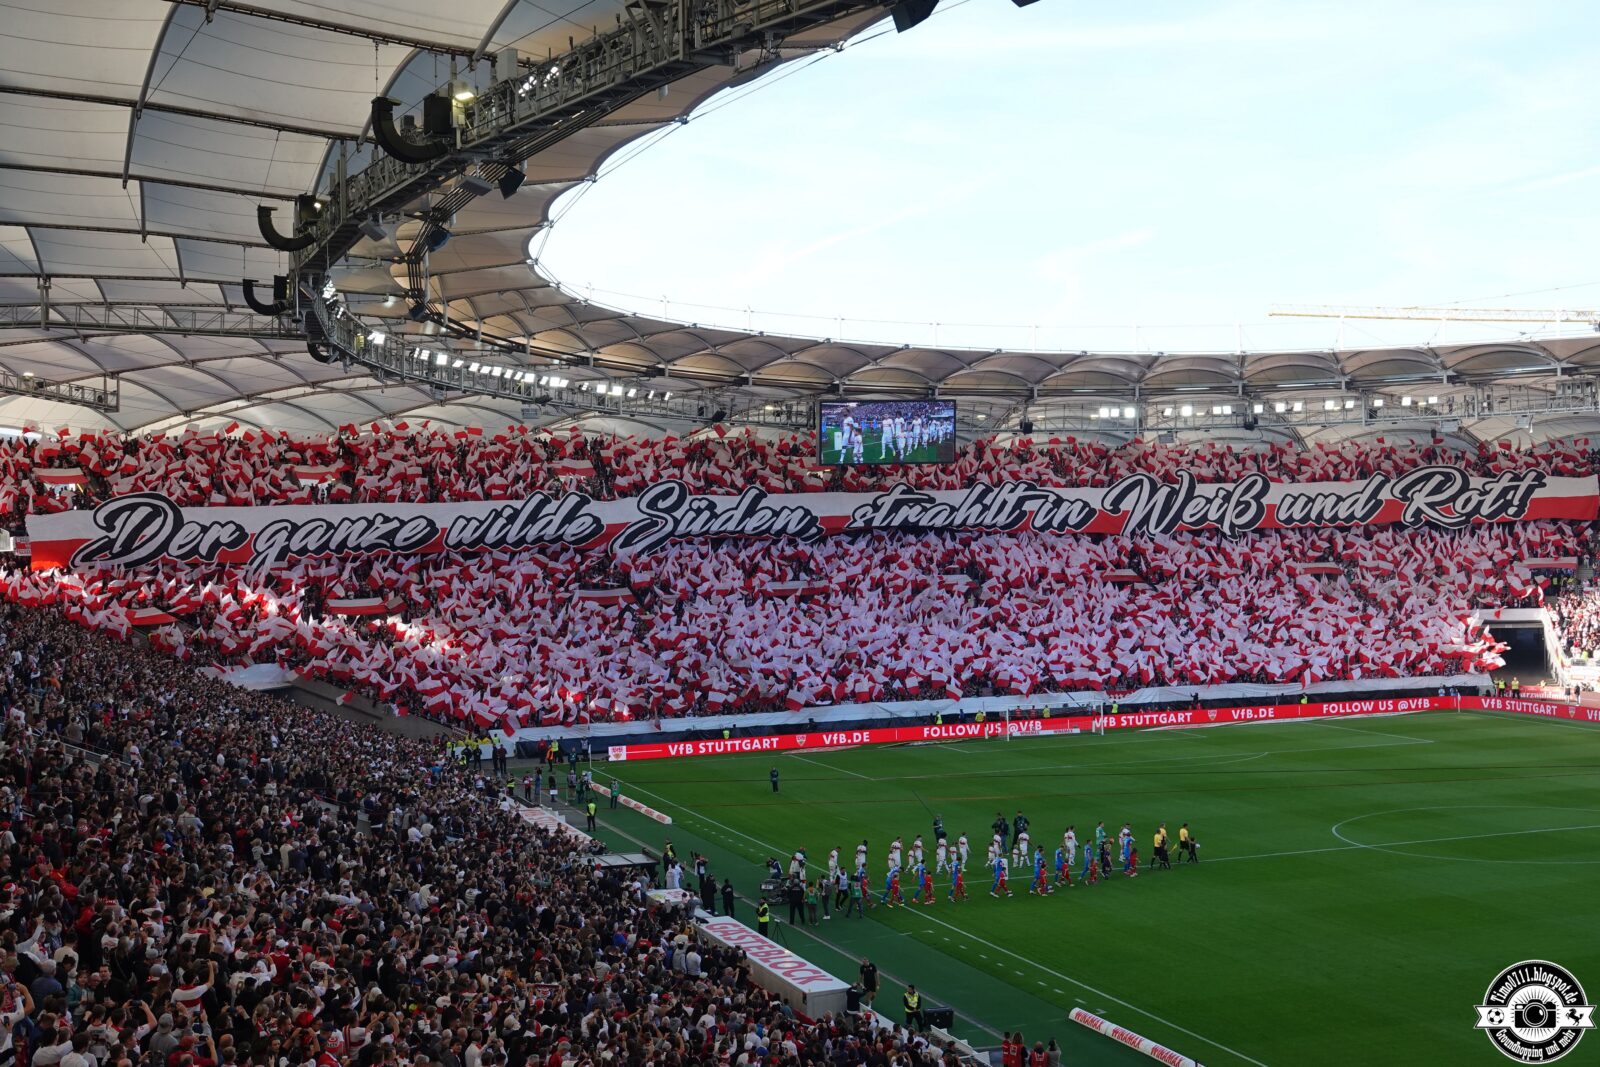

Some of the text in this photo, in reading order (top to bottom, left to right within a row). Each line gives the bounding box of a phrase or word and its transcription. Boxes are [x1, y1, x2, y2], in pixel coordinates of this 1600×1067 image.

[71, 465, 1547, 574] Der ganze wilde Süden, strahlt in Weiß und Rot!
[1231, 708, 1275, 719] VfB.DE
[1323, 699, 1430, 714] FOLLOW US @VfB
[1481, 698, 1558, 715] VfB STUTTGART
[1094, 712, 1193, 728] VfB STUTTGART
[1587, 710, 1600, 720] Vf
[923, 720, 1042, 737] FOLLOW US @VfB
[668, 737, 779, 756] VfB STUTTGART
[822, 732, 870, 745] VfB.DE
